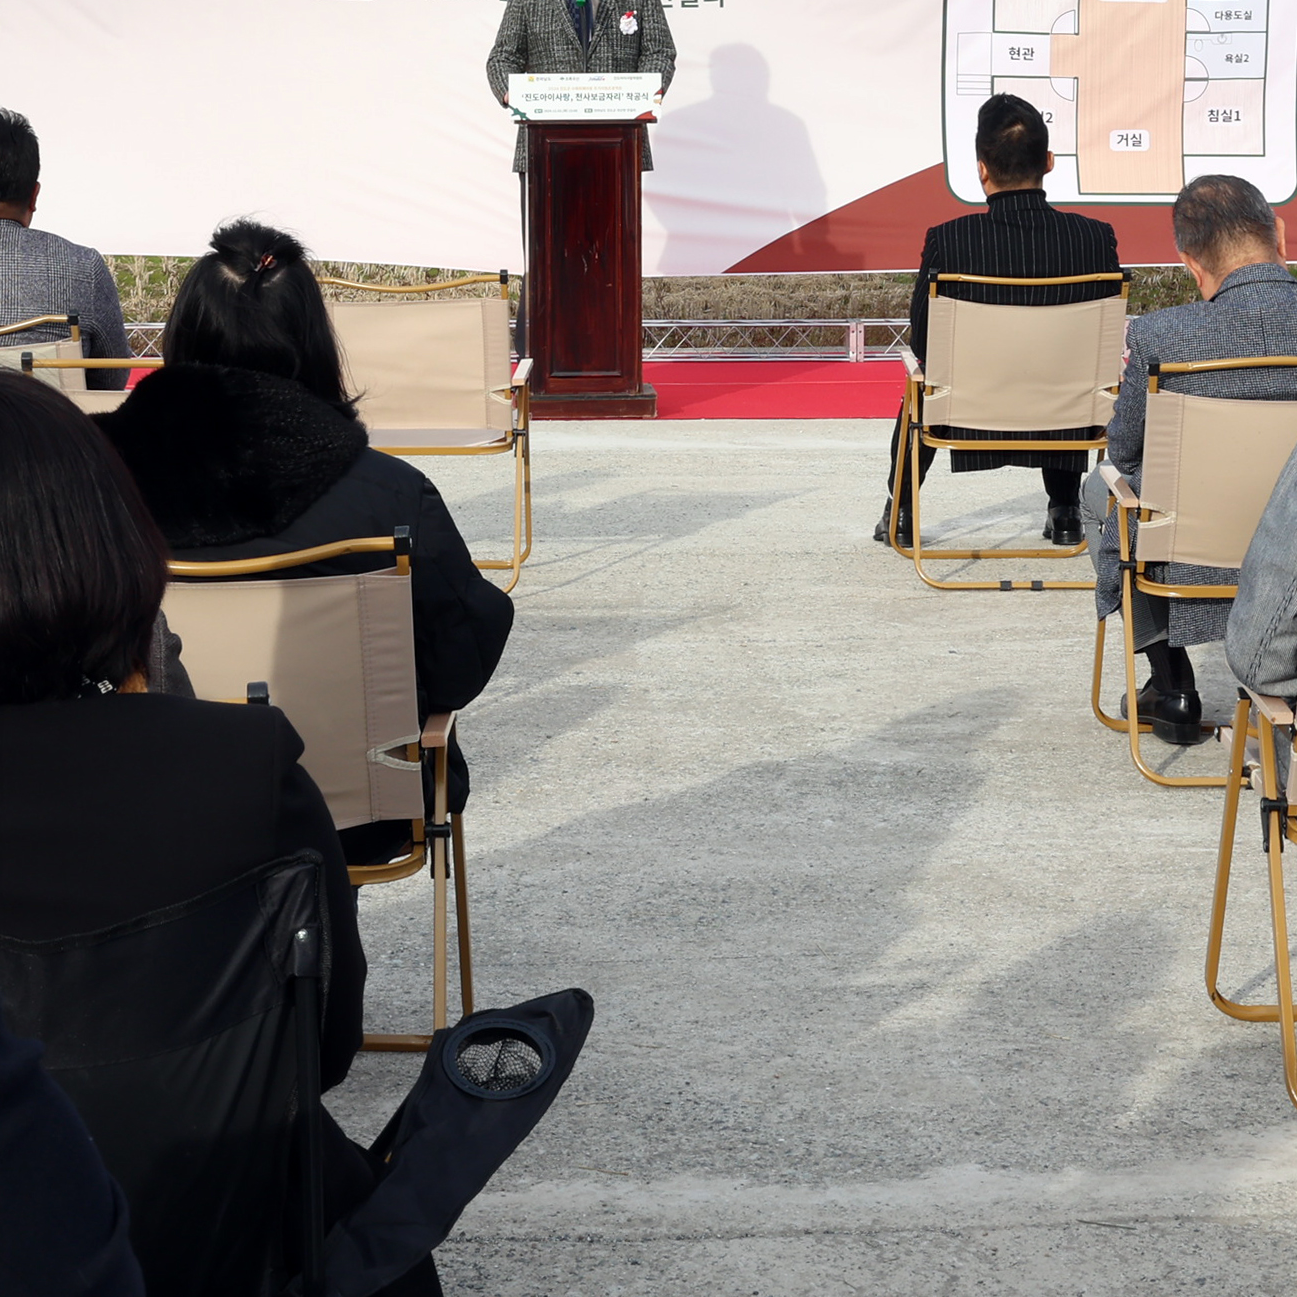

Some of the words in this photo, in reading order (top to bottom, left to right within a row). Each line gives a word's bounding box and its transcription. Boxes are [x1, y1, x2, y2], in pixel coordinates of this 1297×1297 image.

[1214, 10, 1253, 21] 다용도실
[1008, 46, 1035, 61] 현관
[1224, 54, 1250, 64] 욕실2
[1207, 109, 1242, 123] 침실1
[1116, 133, 1143, 148] 거실
